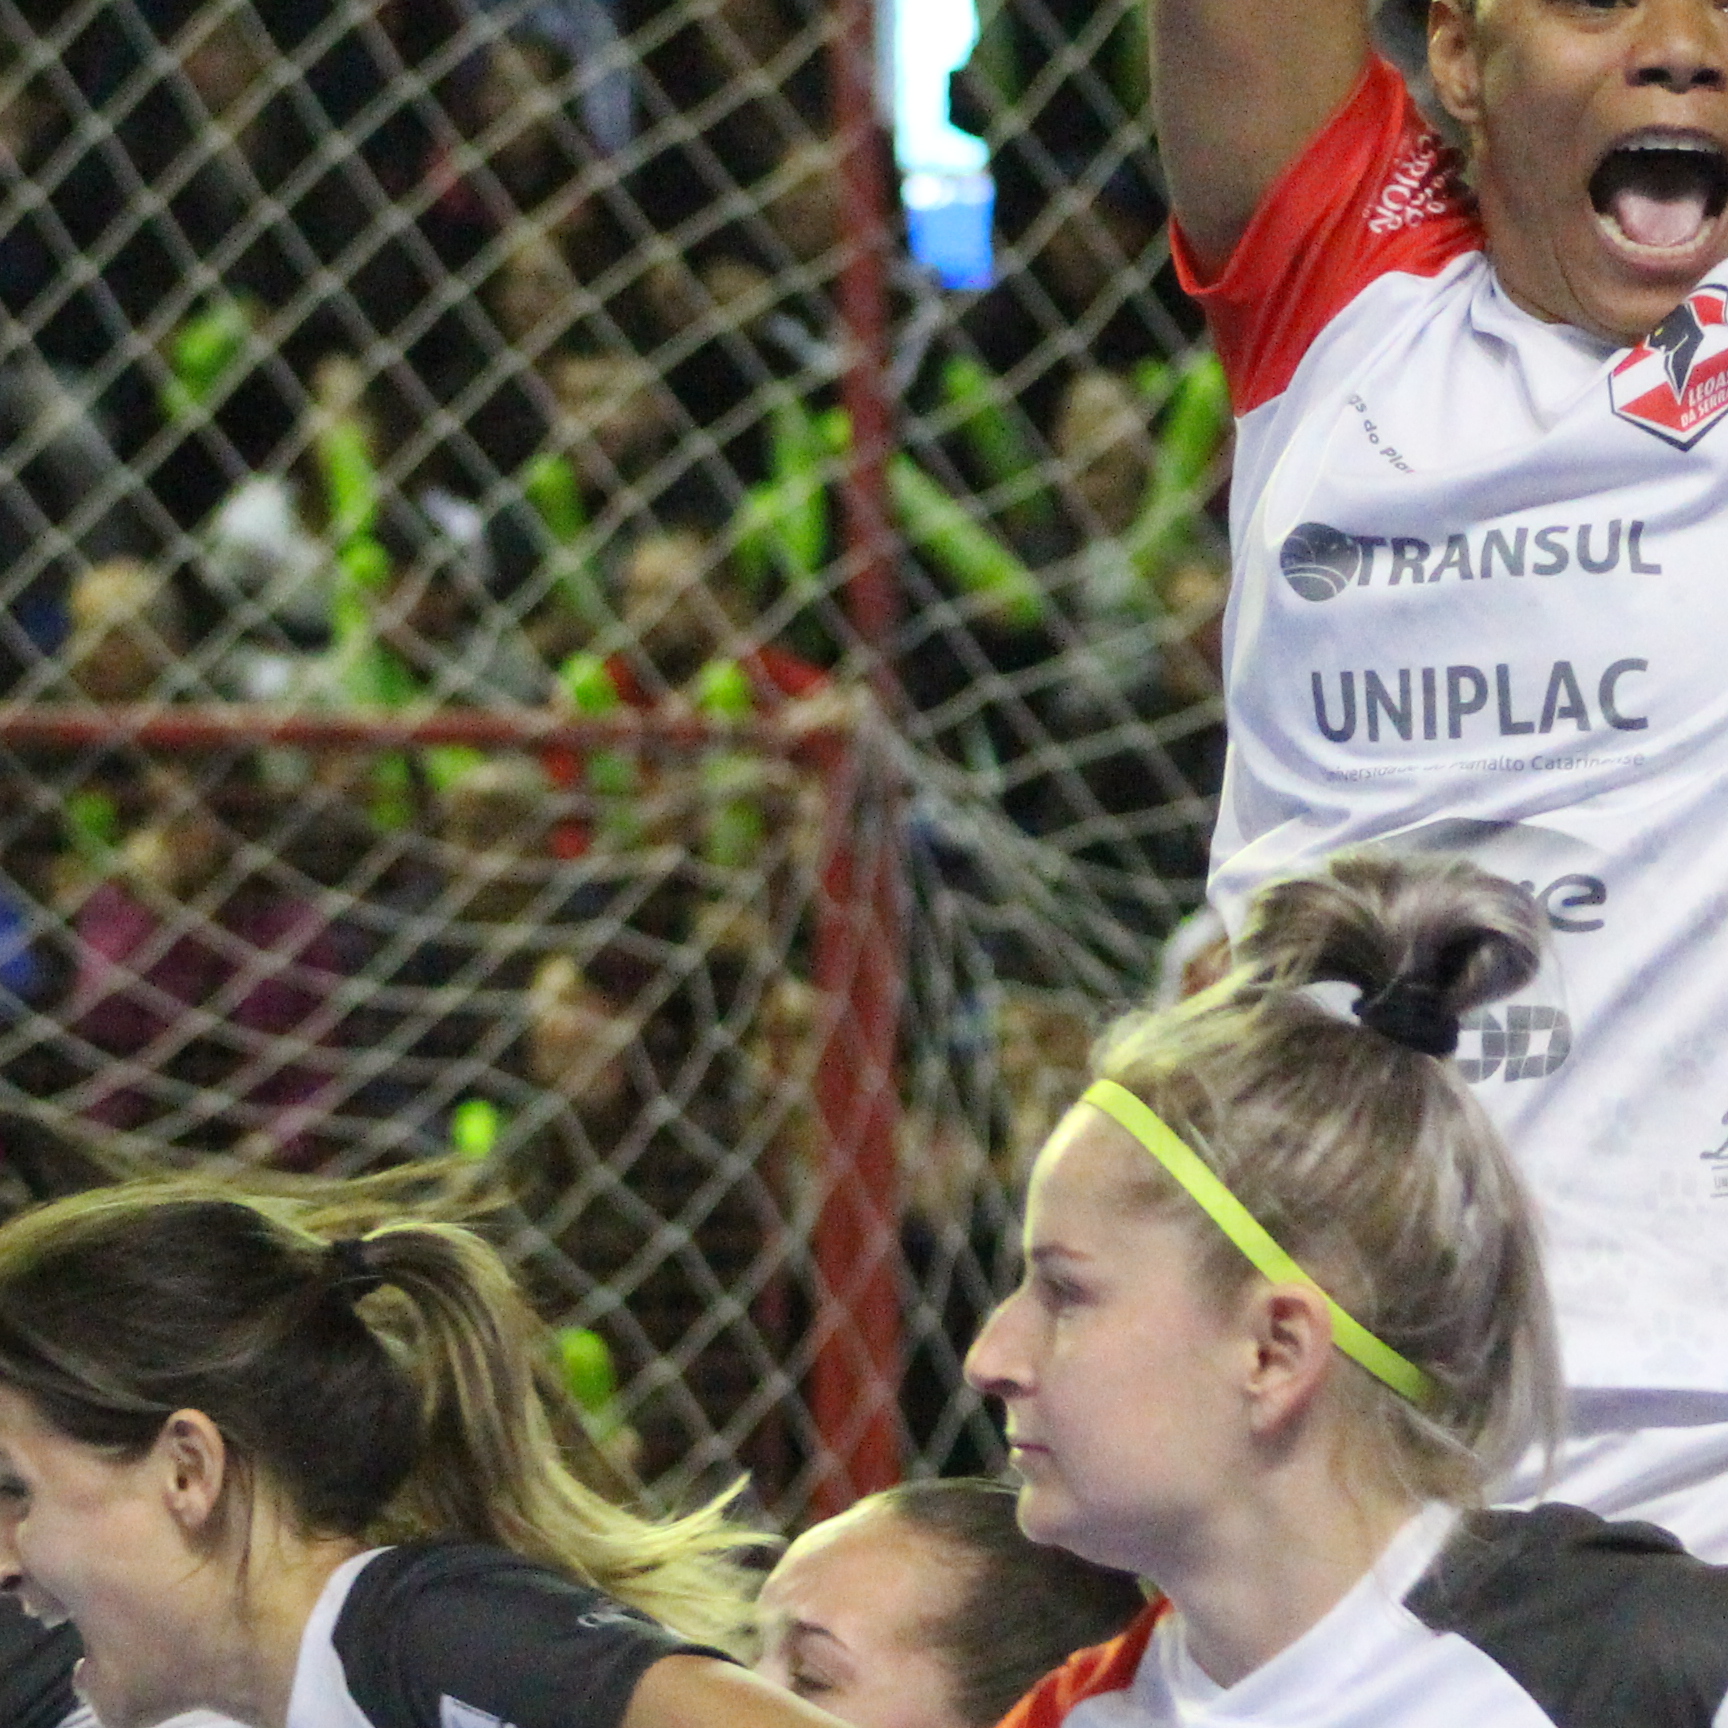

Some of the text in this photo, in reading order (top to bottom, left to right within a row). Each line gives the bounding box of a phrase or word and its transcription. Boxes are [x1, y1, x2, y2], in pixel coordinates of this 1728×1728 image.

[1680, 412, 1697, 428] DA
[1351, 519, 1663, 587] TRANSUL
[1310, 657, 1650, 744] UNIPLAC
